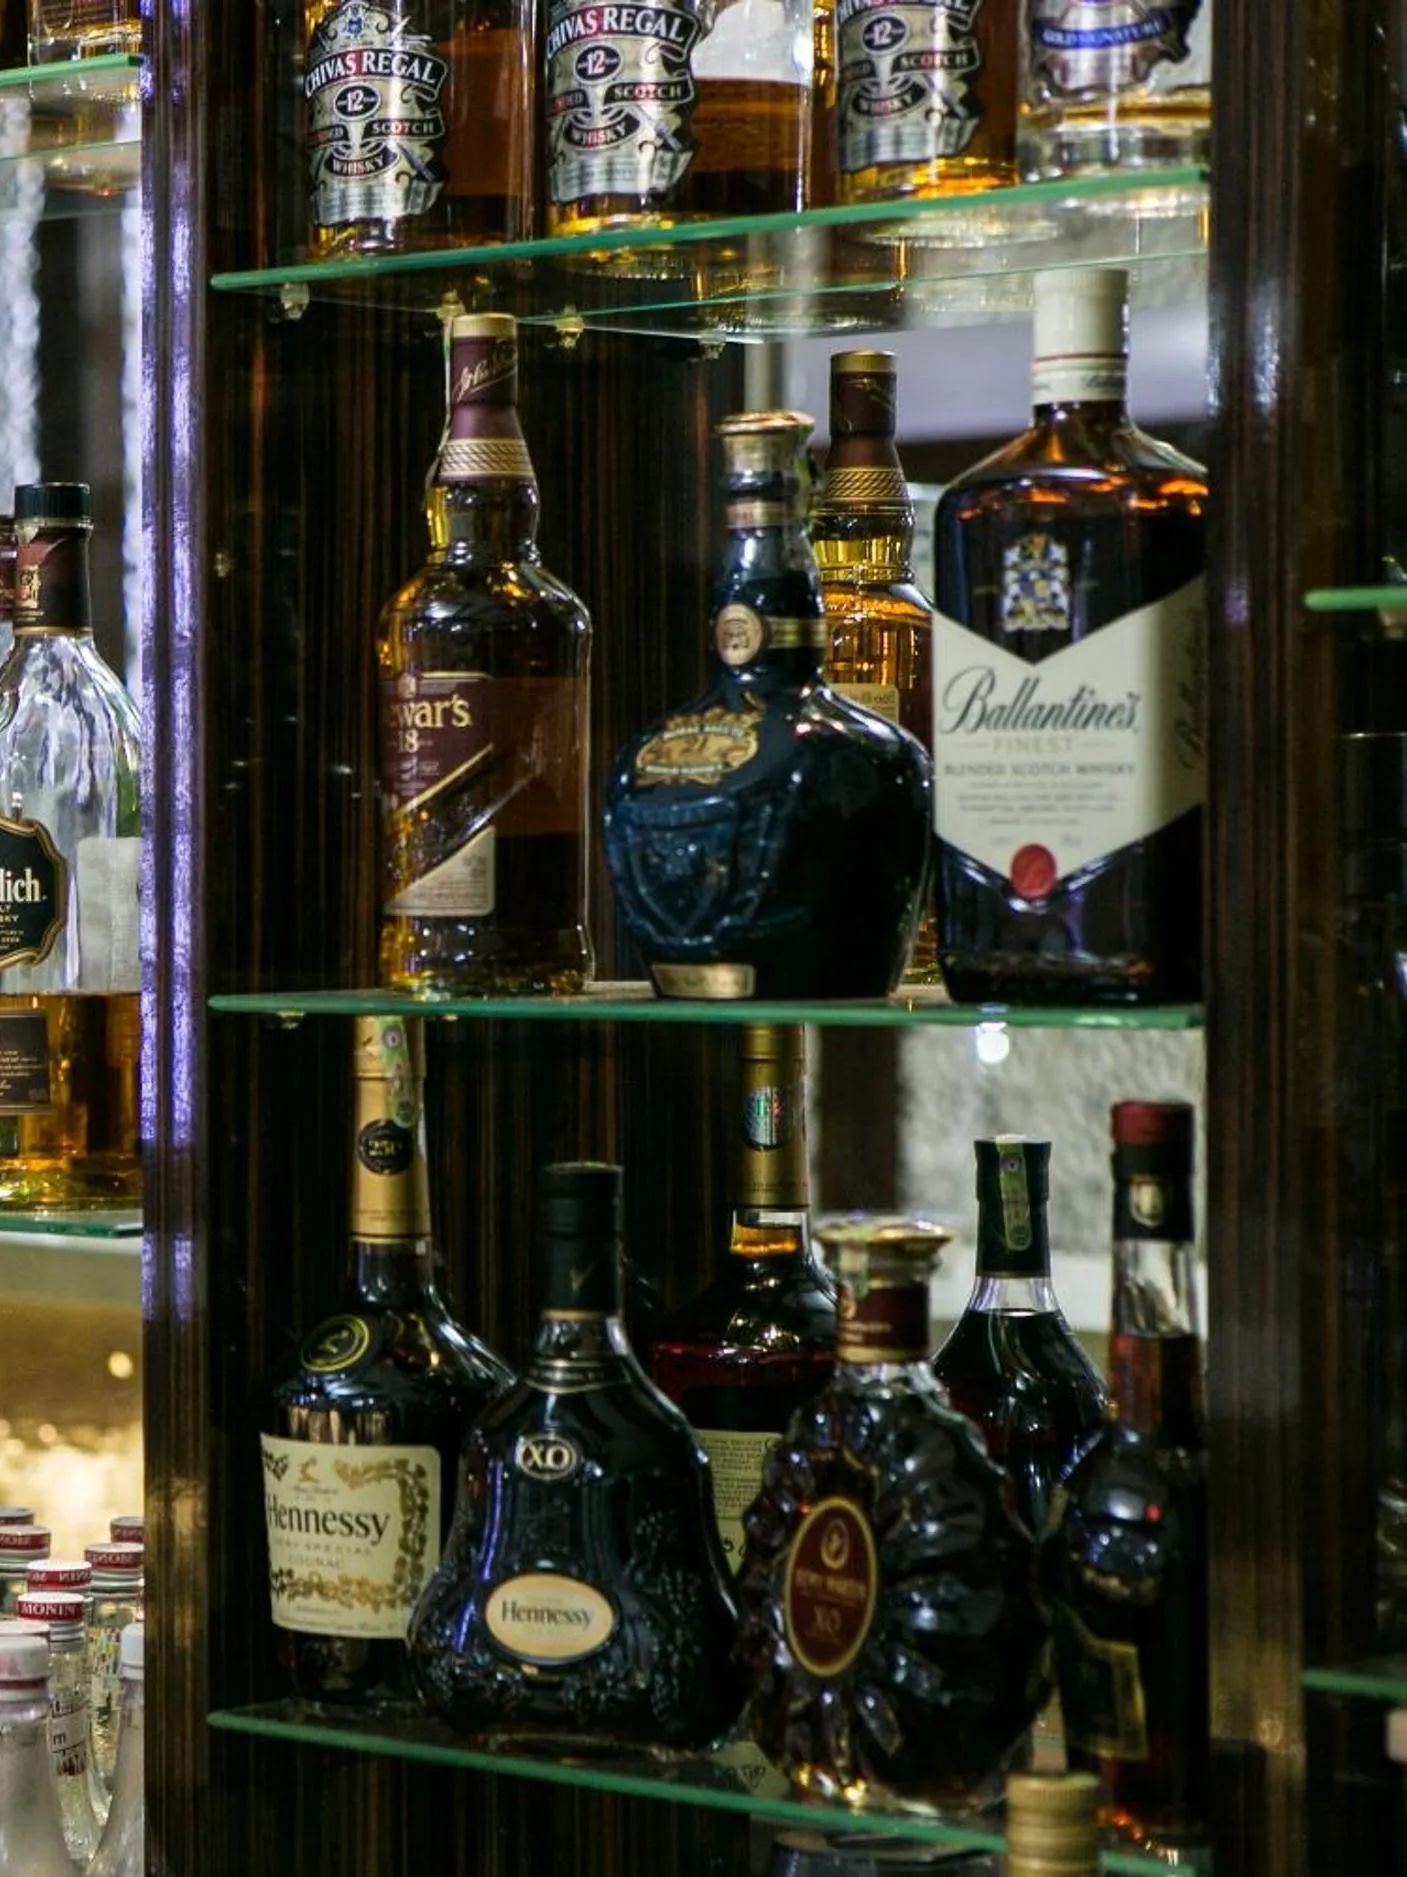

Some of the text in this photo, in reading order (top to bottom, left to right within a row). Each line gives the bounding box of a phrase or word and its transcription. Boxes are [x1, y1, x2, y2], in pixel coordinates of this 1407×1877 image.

[548, 7, 684, 56] CHIVAS REGAL
[873, 20, 892, 45] 12
[587, 49, 605, 75] 12
[900, 53, 969, 67] SCOTCH
[306, 50, 436, 96] CHIVAS REGAL
[347, 89, 364, 112] 12
[614, 86, 681, 99] SCOTCH
[372, 120, 434, 134] SCOTCH
[571, 122, 627, 144] WHISKY
[332, 154, 384, 174] WHISKY
[940, 665, 1142, 736] Ballantine's
[398, 729, 419, 753] 18
[524, 1444, 570, 1469] XO
[267, 1492, 391, 1547] Hennessy
[21, 1603, 77, 1617] MONIN
[502, 1600, 591, 1630] Hennessy
